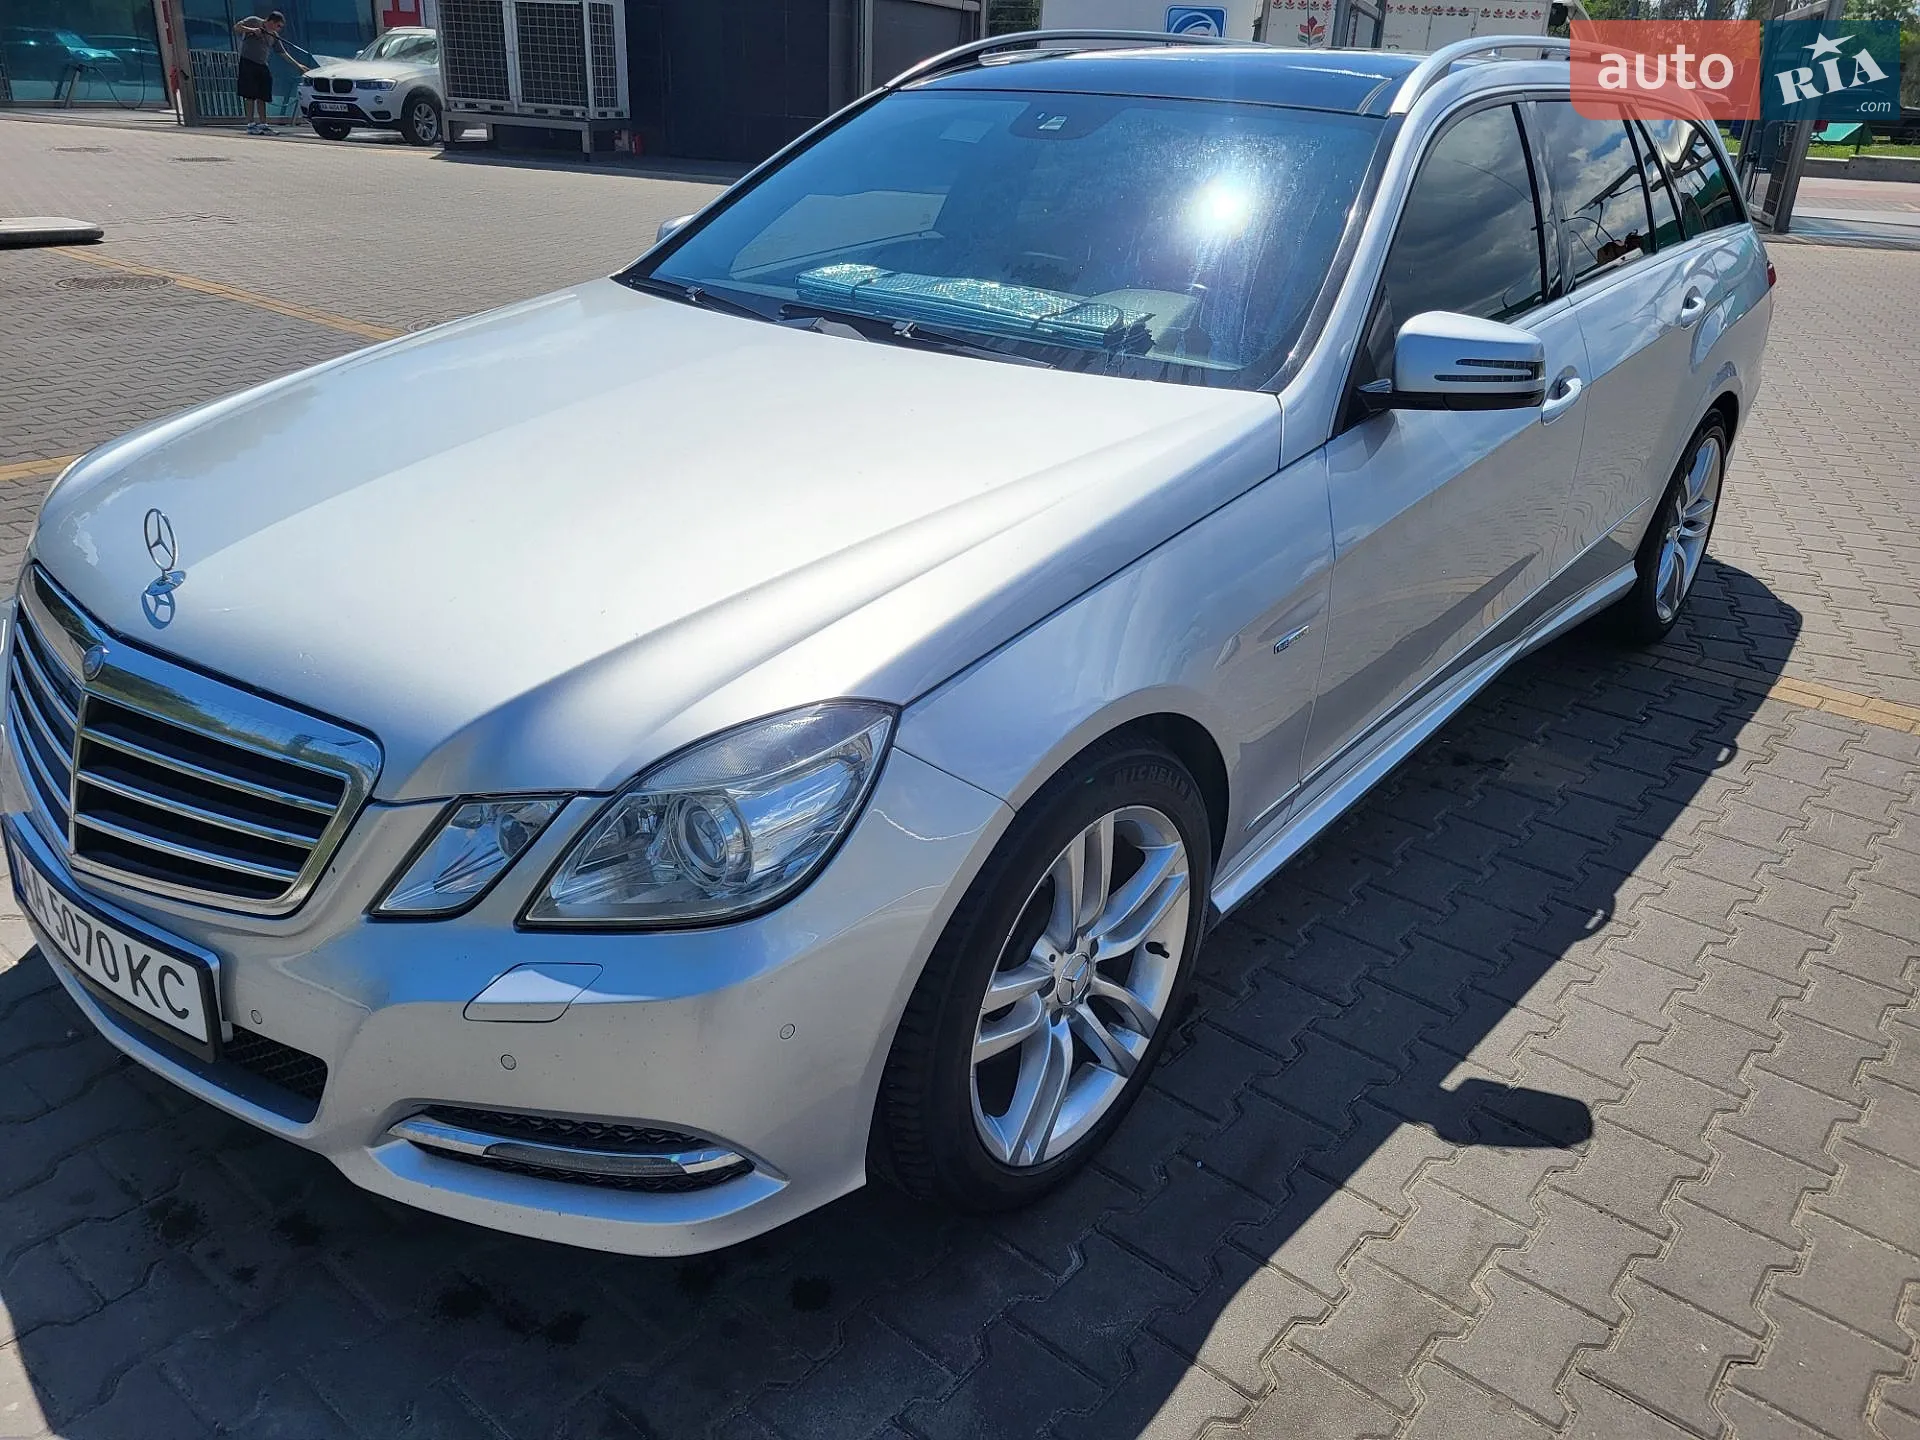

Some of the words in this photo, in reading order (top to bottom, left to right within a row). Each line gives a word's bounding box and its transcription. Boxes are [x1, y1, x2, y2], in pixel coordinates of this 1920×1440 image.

[1113, 764, 1192, 800] MICHELIN
[47, 886, 120, 984] 5070
[124, 943, 190, 1020] KC
